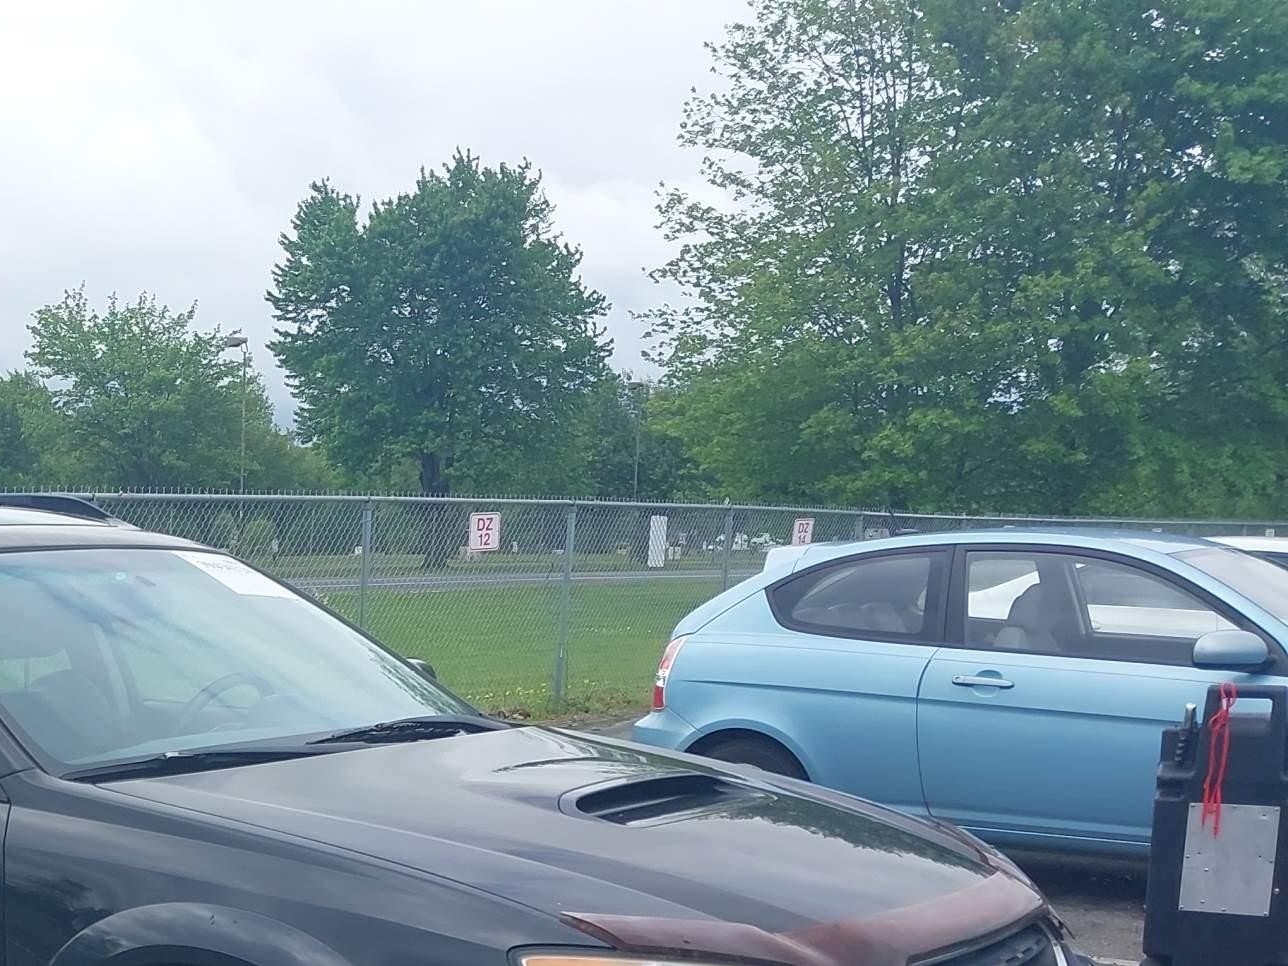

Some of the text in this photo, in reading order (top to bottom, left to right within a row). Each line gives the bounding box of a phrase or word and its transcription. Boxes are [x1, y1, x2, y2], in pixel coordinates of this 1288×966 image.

[476, 517, 494, 531] DZ
[797, 522, 810, 534] DZ
[477, 532, 491, 546] 12
